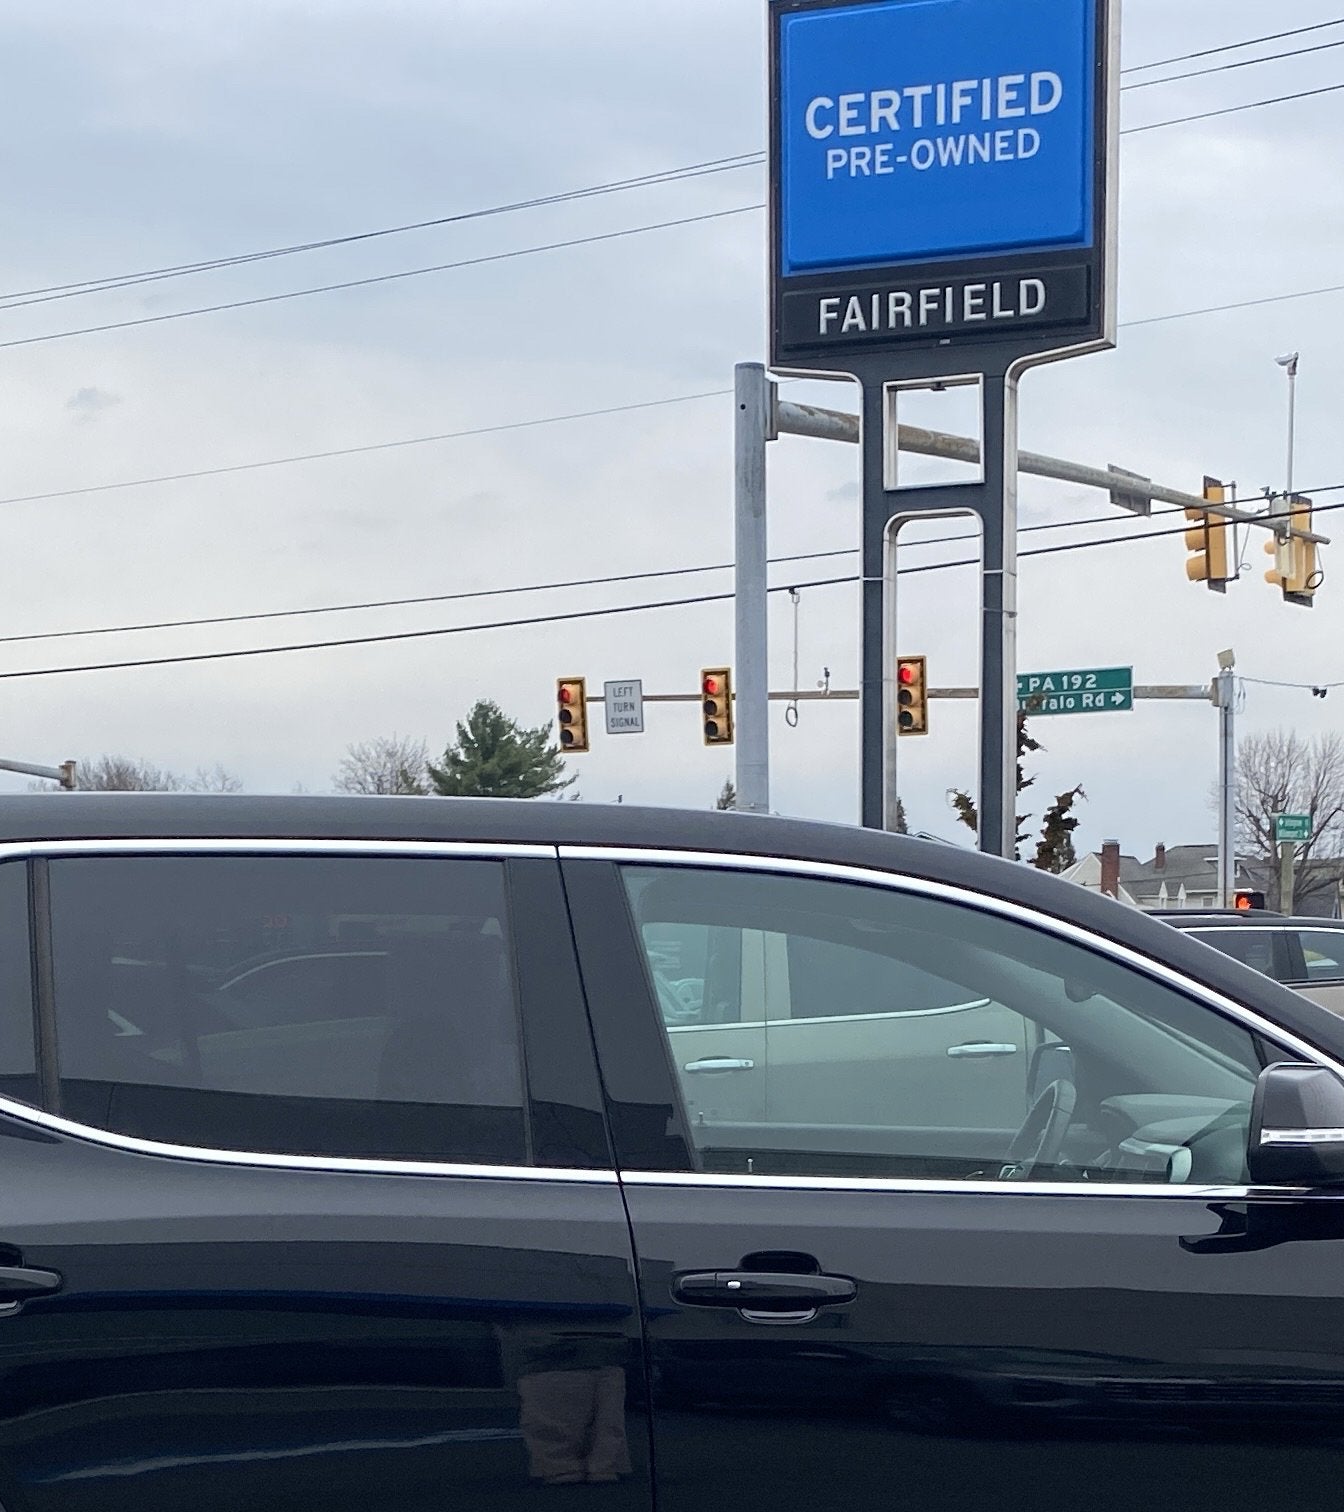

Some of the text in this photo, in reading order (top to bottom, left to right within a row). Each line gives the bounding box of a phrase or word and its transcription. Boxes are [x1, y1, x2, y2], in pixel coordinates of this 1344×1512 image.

[805, 71, 1063, 139] CERTIFIED
[826, 127, 1041, 180] PRE-OWNED
[818, 278, 1047, 336] FAIRFIELD
[1029, 673, 1097, 692] PA 192
[612, 686, 633, 698] LEFT
[1082, 693, 1105, 708] Rd
[613, 701, 635, 713] TURN
[610, 716, 641, 728] SIGNAL
